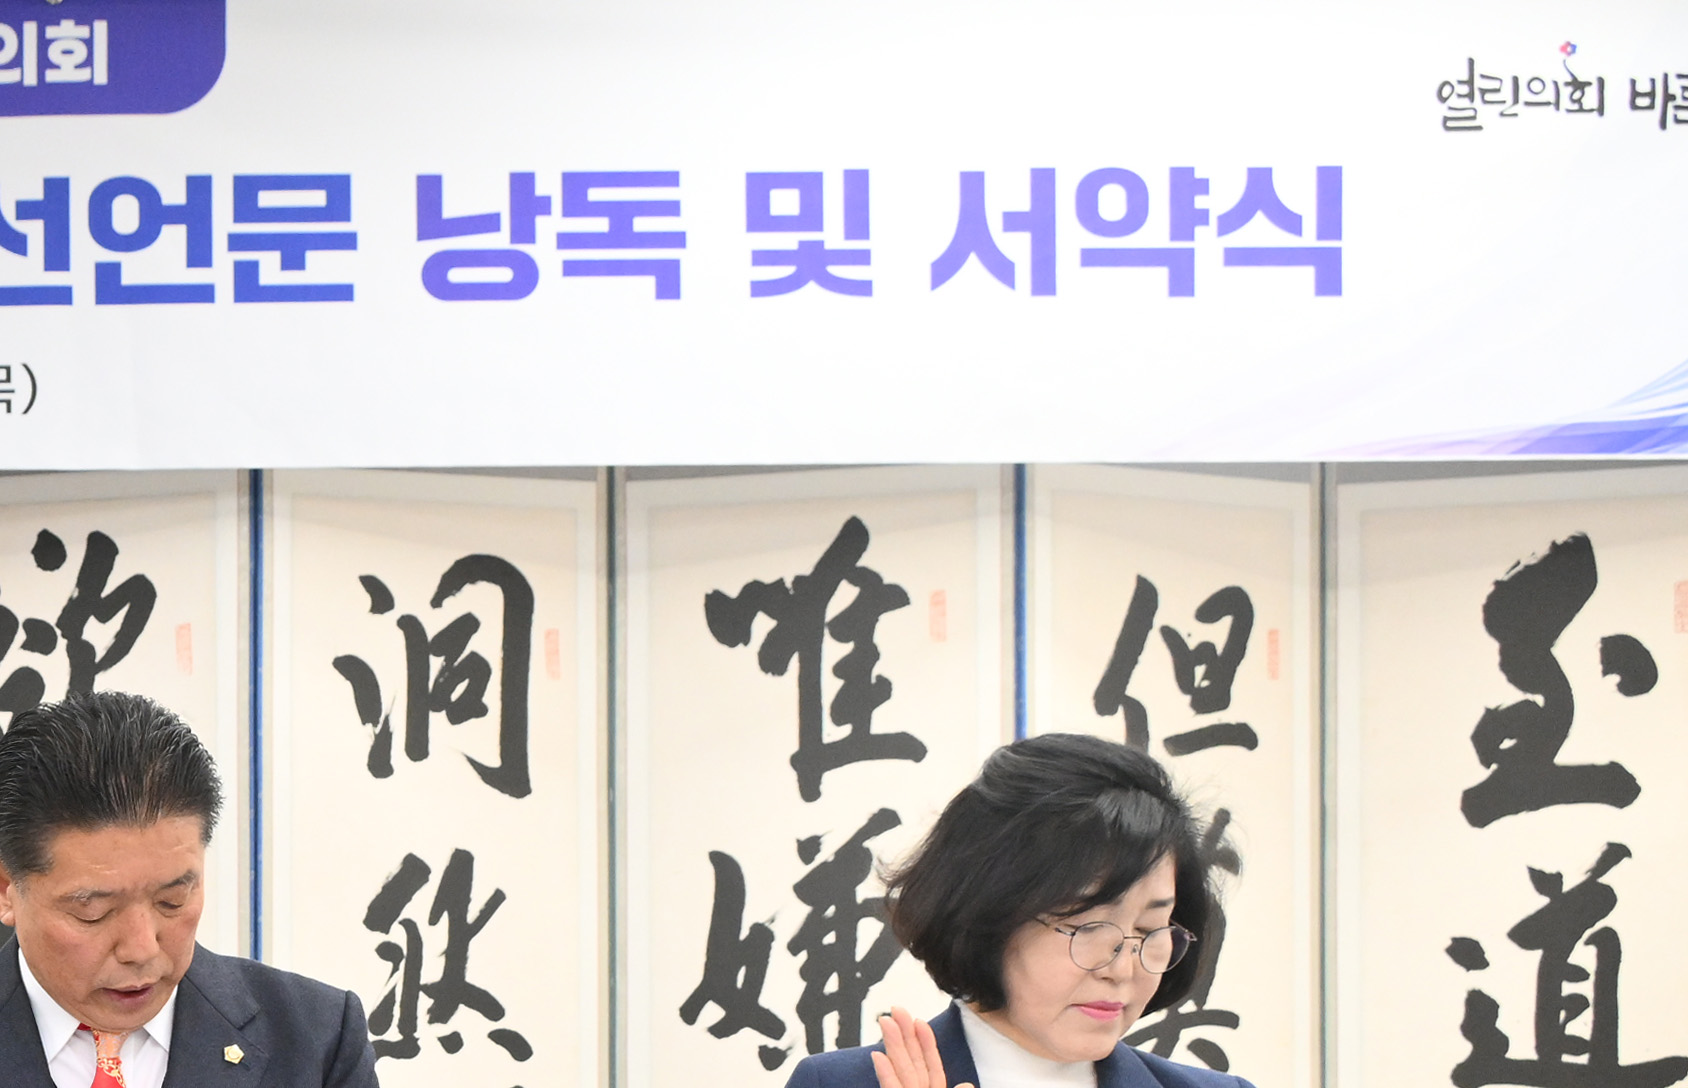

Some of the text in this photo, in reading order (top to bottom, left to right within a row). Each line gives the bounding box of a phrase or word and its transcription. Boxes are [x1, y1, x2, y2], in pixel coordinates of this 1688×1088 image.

[1438, 57, 1605, 131] 열린의회
[417, 170, 687, 302] 낭독
[744, 168, 874, 298] 및
[930, 165, 1344, 297] 서약식
